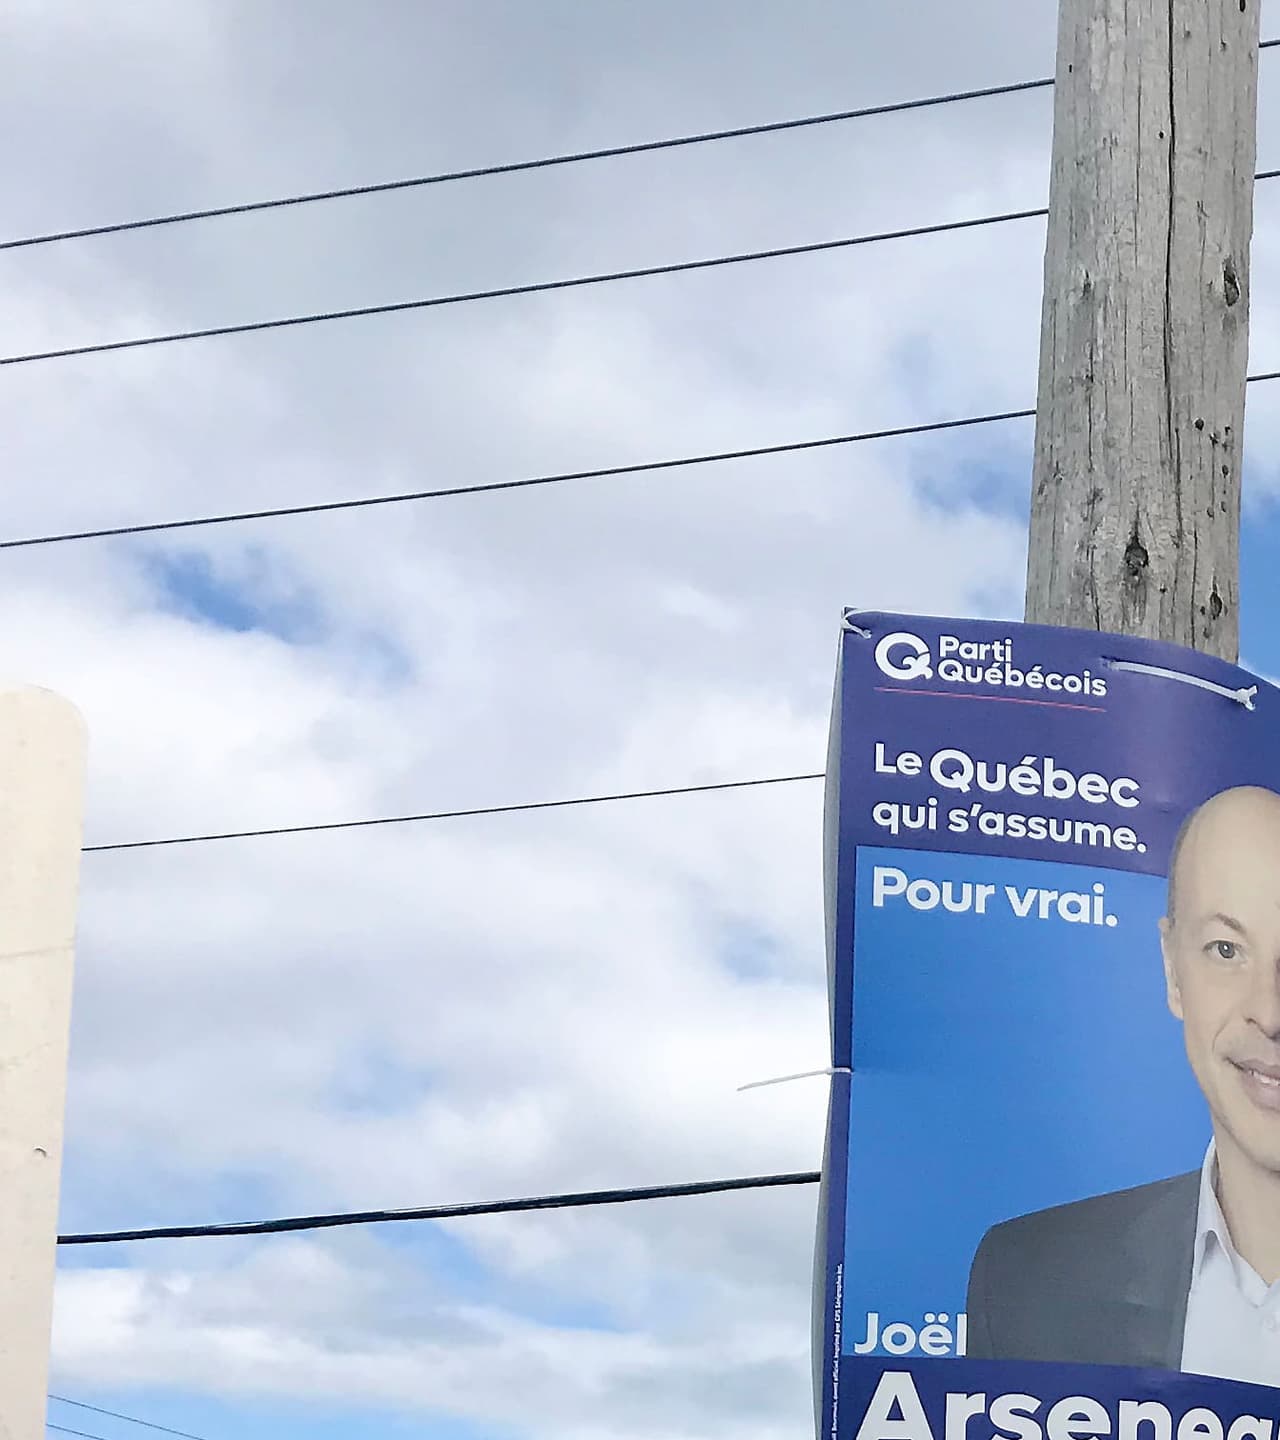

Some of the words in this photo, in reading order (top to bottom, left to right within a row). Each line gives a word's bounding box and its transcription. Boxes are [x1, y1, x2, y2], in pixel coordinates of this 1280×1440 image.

[939, 635, 1012, 662] Parti
[937, 658, 1108, 697] Québécois
[874, 742, 923, 775] Le
[929, 748, 1141, 808] Québec
[872, 797, 938, 834] qui
[947, 803, 1147, 853] s'assume.
[872, 866, 996, 914] Pour
[1004, 883, 1119, 928] vrai.
[853, 1312, 968, 1356] Joël
